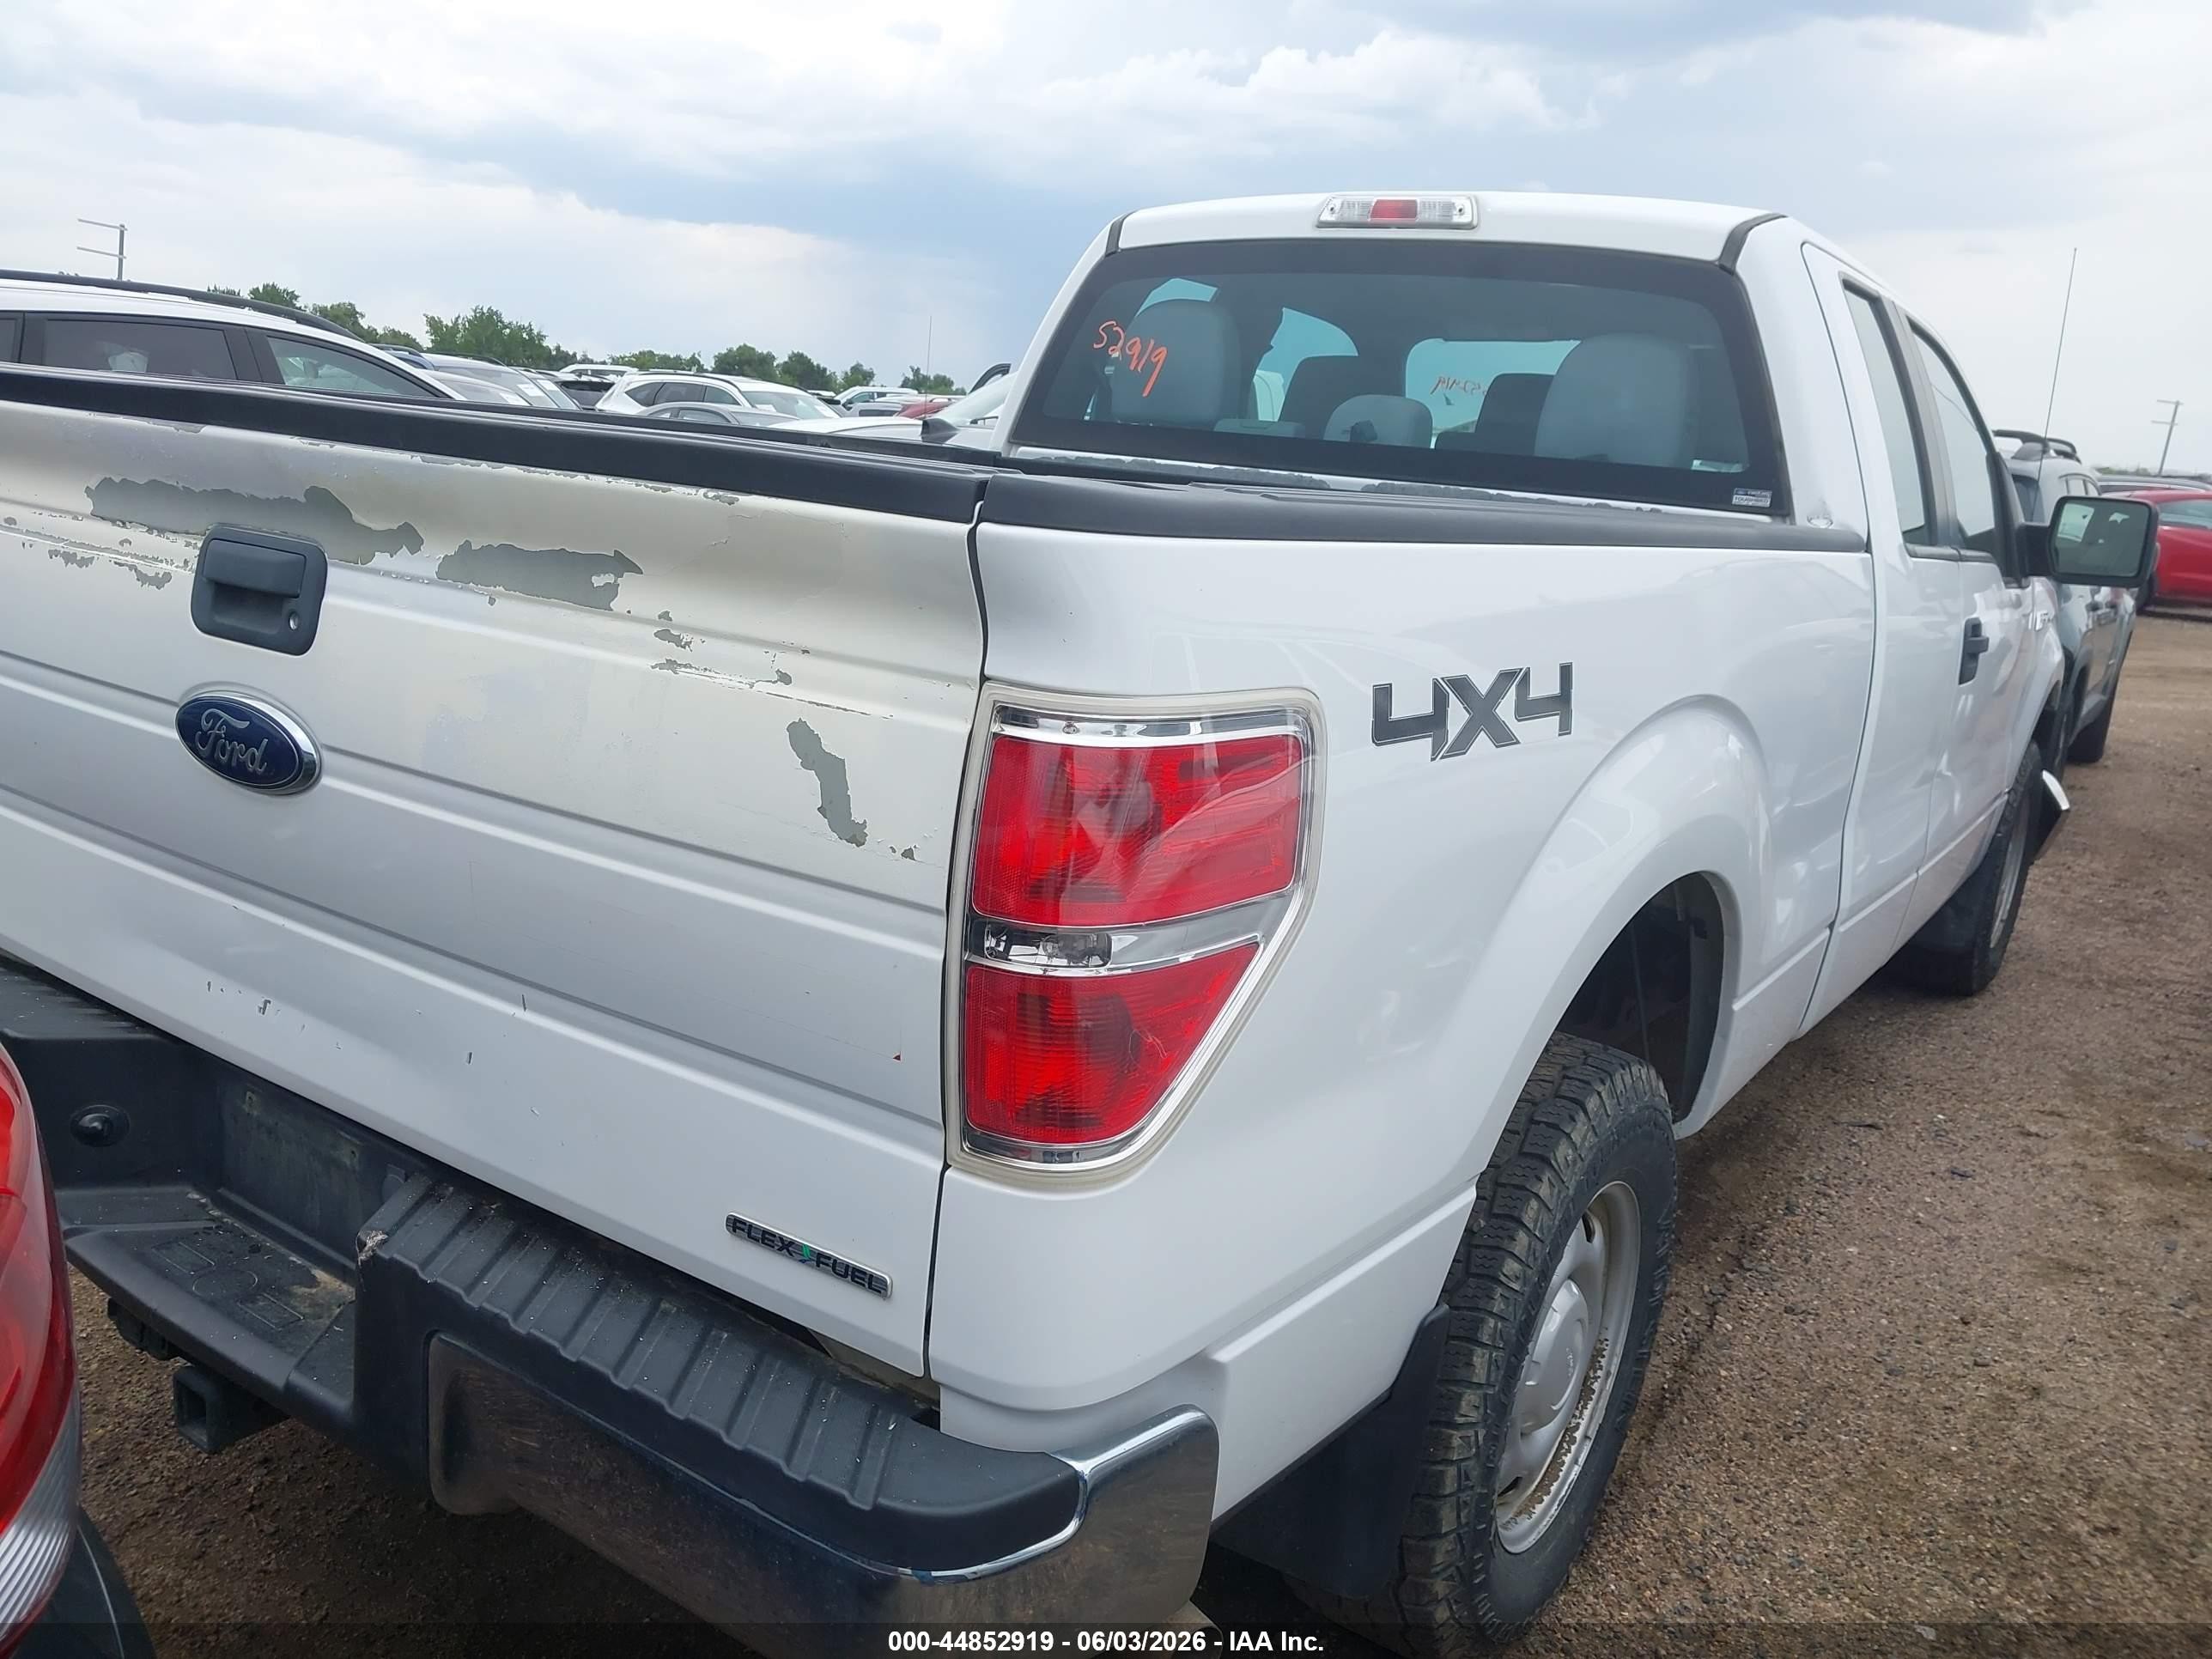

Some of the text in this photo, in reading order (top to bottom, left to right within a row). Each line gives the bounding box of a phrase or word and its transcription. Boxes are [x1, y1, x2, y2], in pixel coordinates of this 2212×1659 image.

[195, 708, 269, 772] Ford
[732, 1218, 884, 1295] FLEX FUEL
